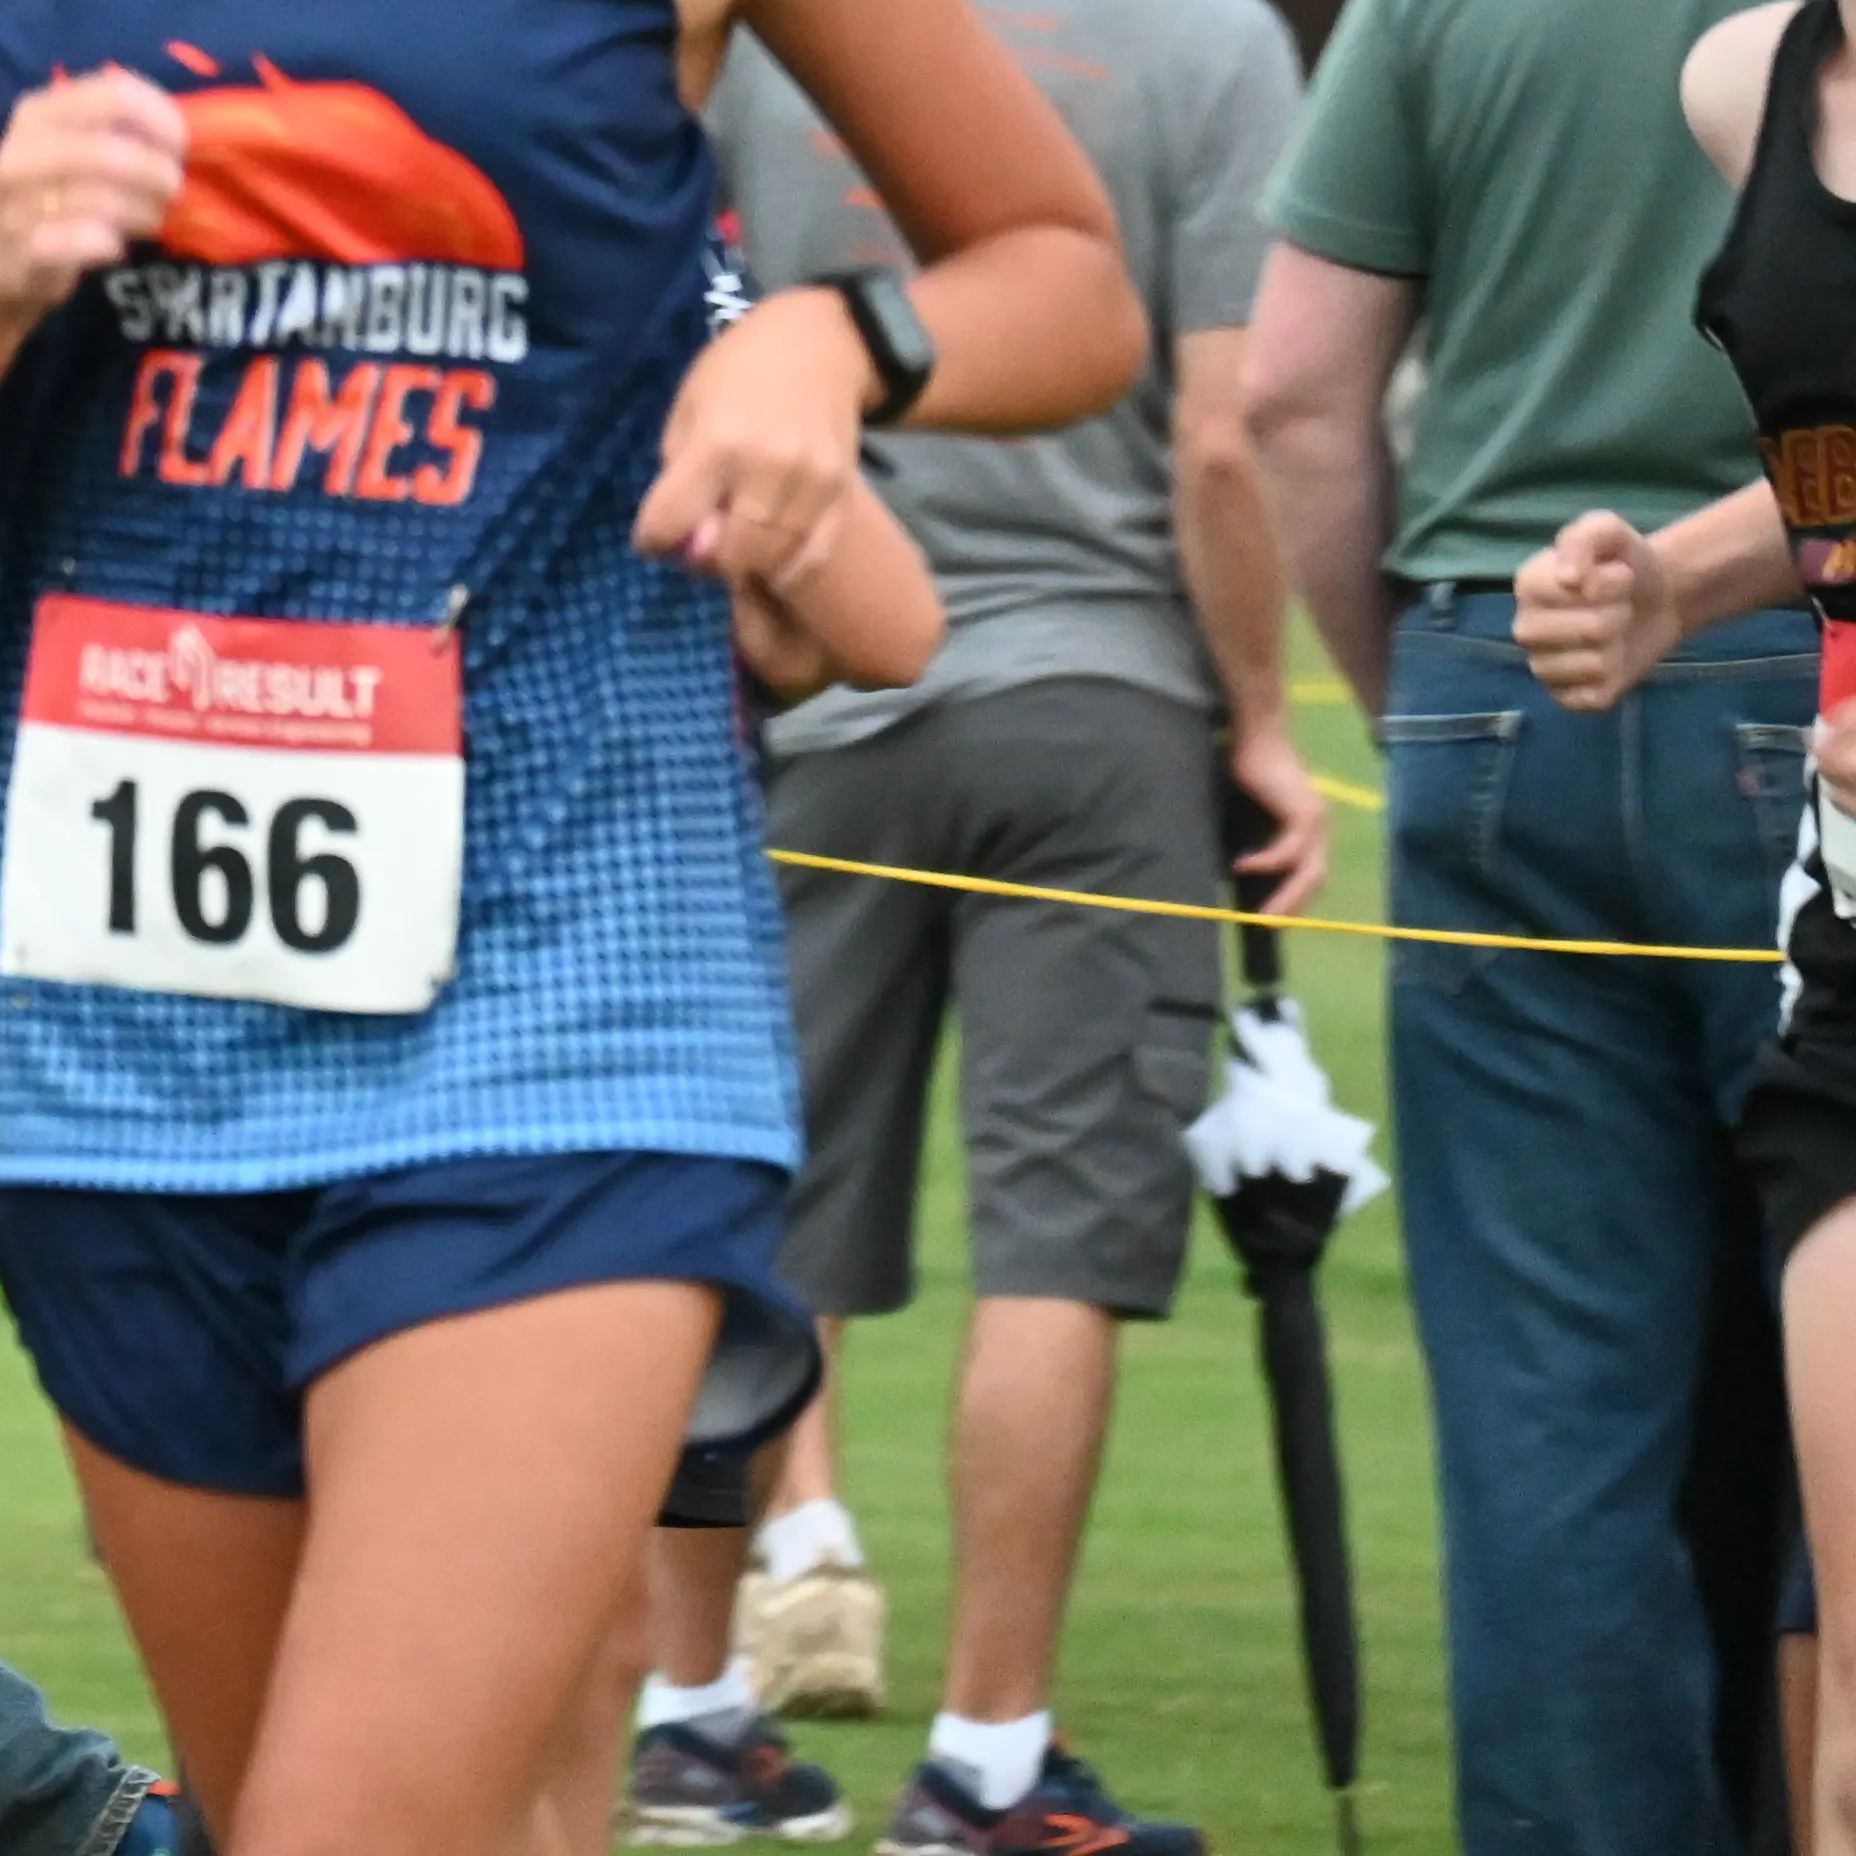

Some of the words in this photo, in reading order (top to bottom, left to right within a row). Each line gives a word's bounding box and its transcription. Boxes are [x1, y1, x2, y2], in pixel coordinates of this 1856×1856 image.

[104, 257, 531, 364] SPARTANBURG
[119, 348, 498, 506] FLAMES
[79, 642, 170, 705] RACE
[211, 659, 384, 719] RESULT
[91, 776, 362, 956] 166
